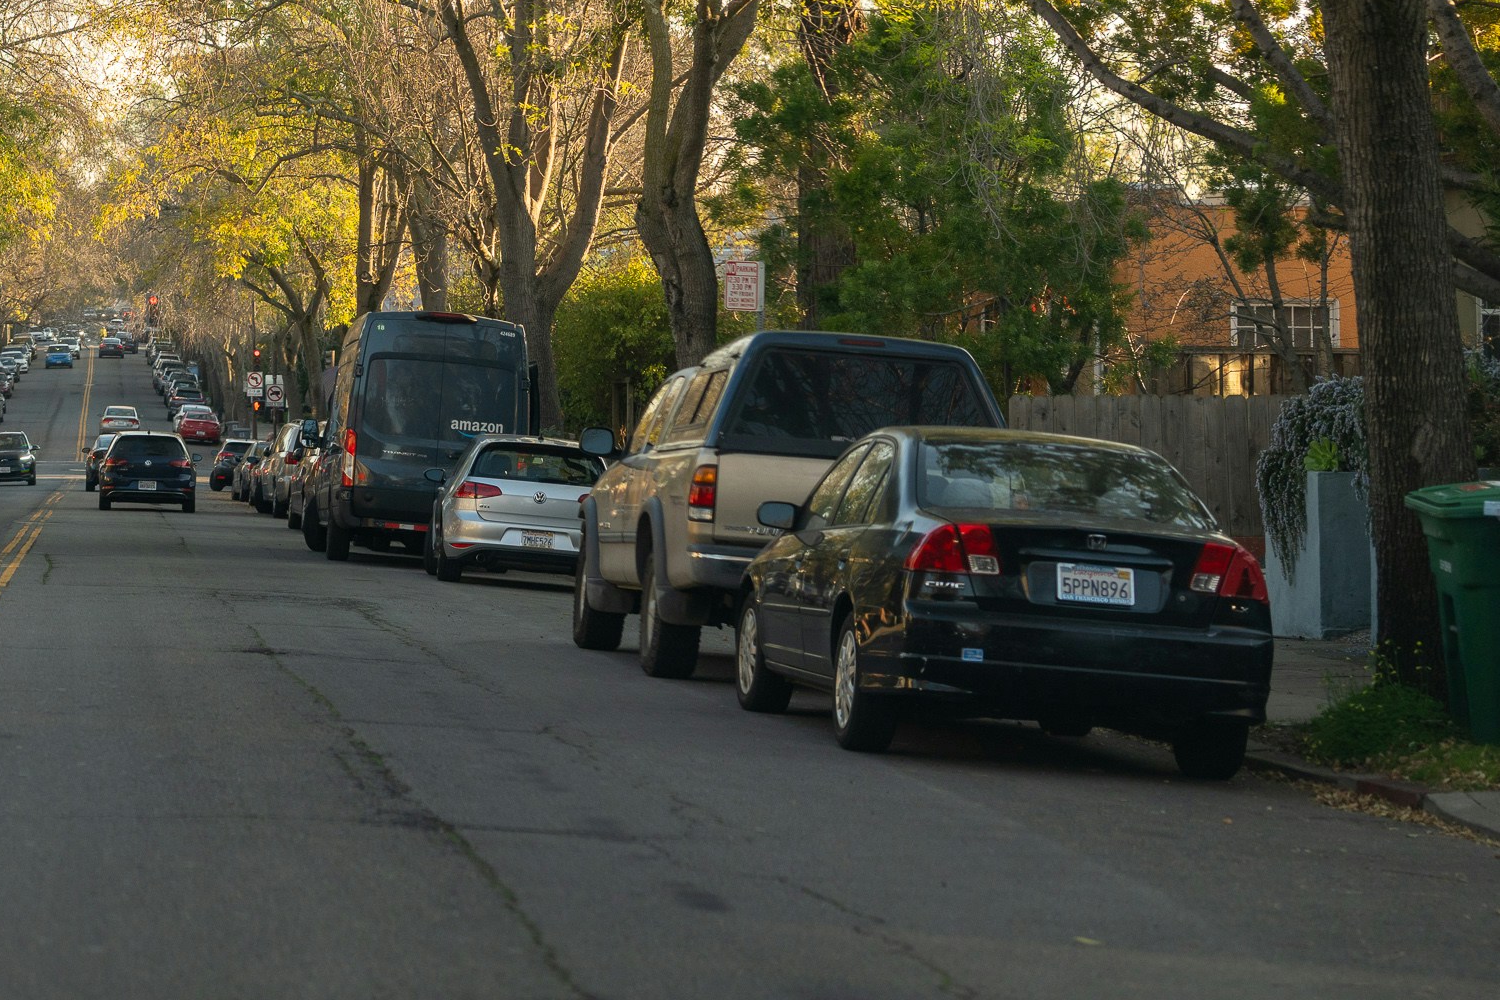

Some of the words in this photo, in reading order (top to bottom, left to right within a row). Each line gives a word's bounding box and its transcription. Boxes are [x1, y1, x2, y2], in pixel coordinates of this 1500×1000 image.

[725, 263, 736, 274] NO
[736, 265, 758, 273] PARKING
[450, 419, 504, 434] amazon
[925, 580, 965, 589] CIVIC
[1062, 577, 1129, 599] 5PPN896
